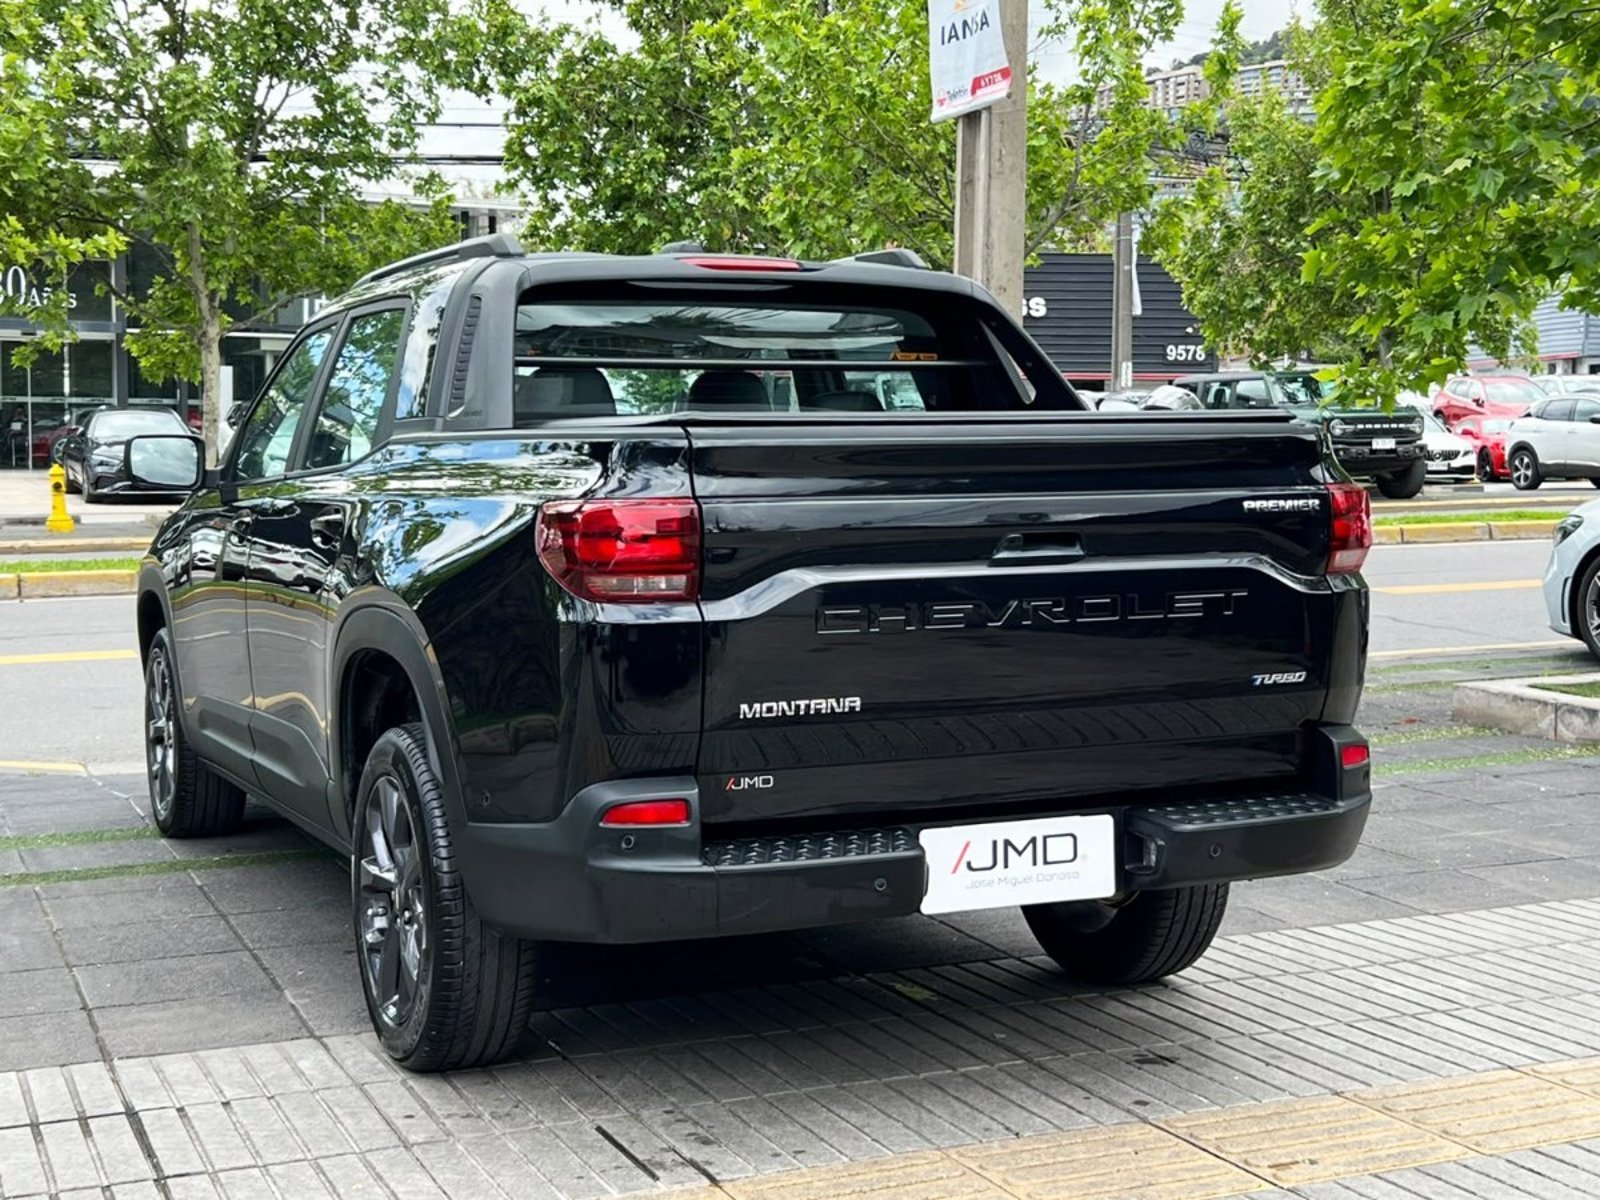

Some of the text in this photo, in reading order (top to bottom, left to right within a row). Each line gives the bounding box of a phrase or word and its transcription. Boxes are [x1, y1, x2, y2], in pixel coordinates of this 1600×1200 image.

[1166, 344, 1206, 362] 9578
[1242, 498, 1321, 512] PREMIER
[816, 588, 1249, 635] CHEVROLET
[1252, 671, 1307, 686] TURBO
[738, 696, 862, 720] MONTANA
